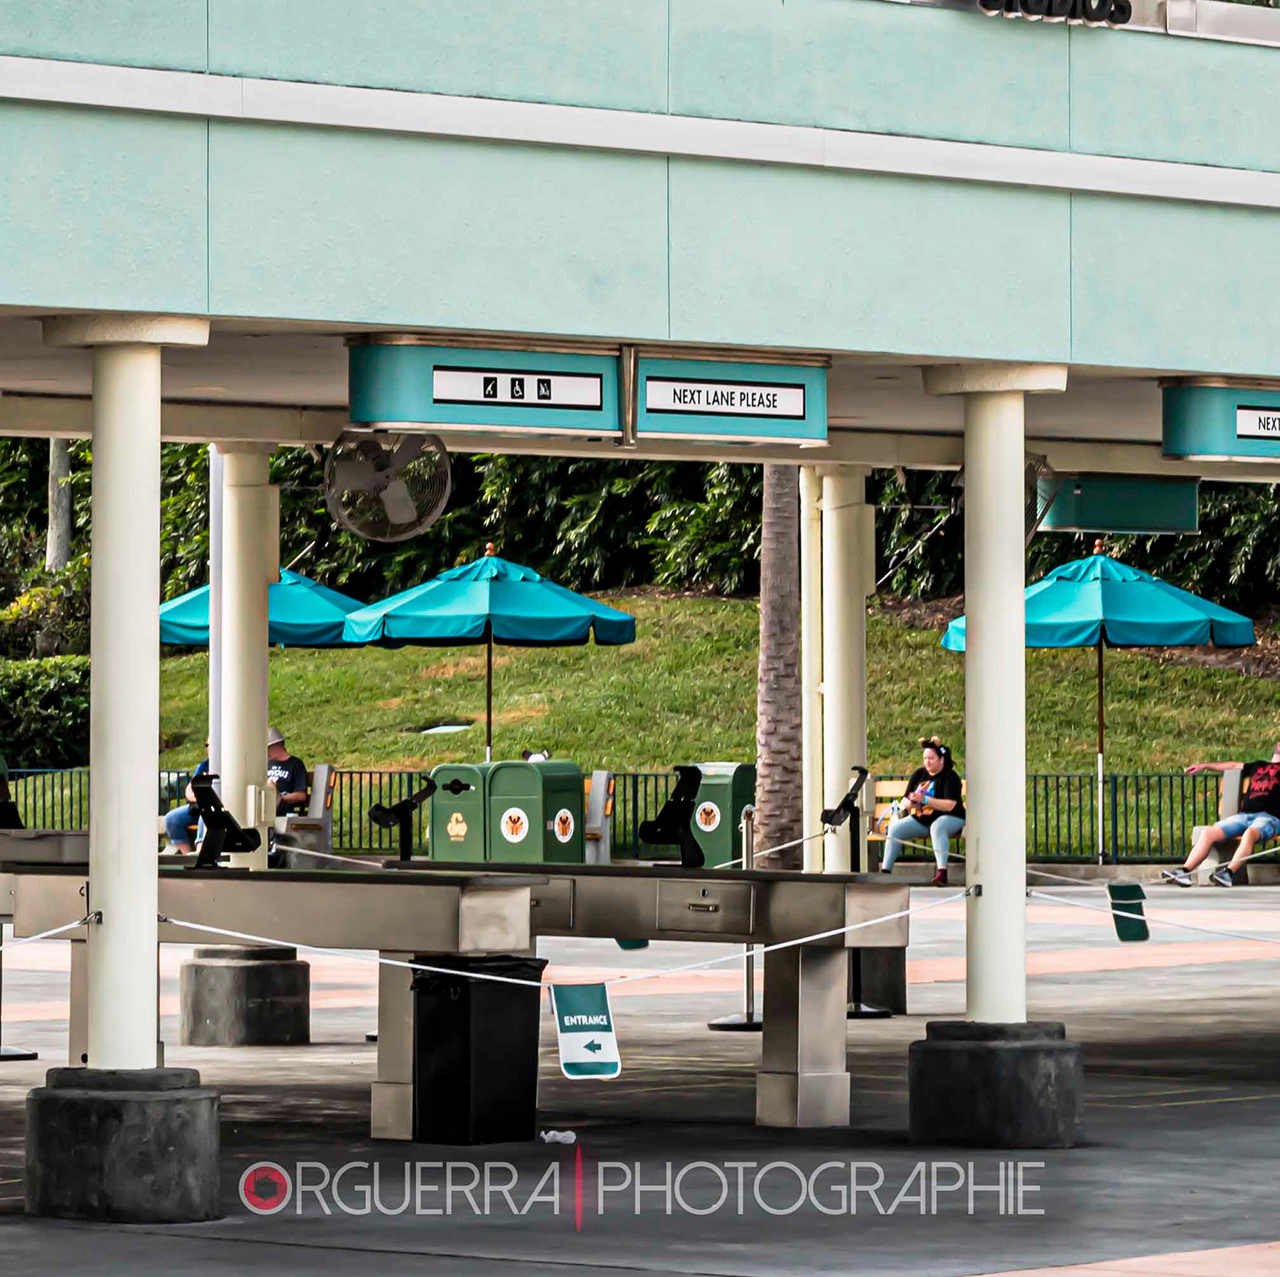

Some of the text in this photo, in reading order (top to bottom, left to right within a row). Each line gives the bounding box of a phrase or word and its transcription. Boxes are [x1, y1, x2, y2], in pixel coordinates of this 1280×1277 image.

[673, 388, 778, 409] NEXT LANE PLEASE
[564, 1014, 608, 1026] ENTRANCE
